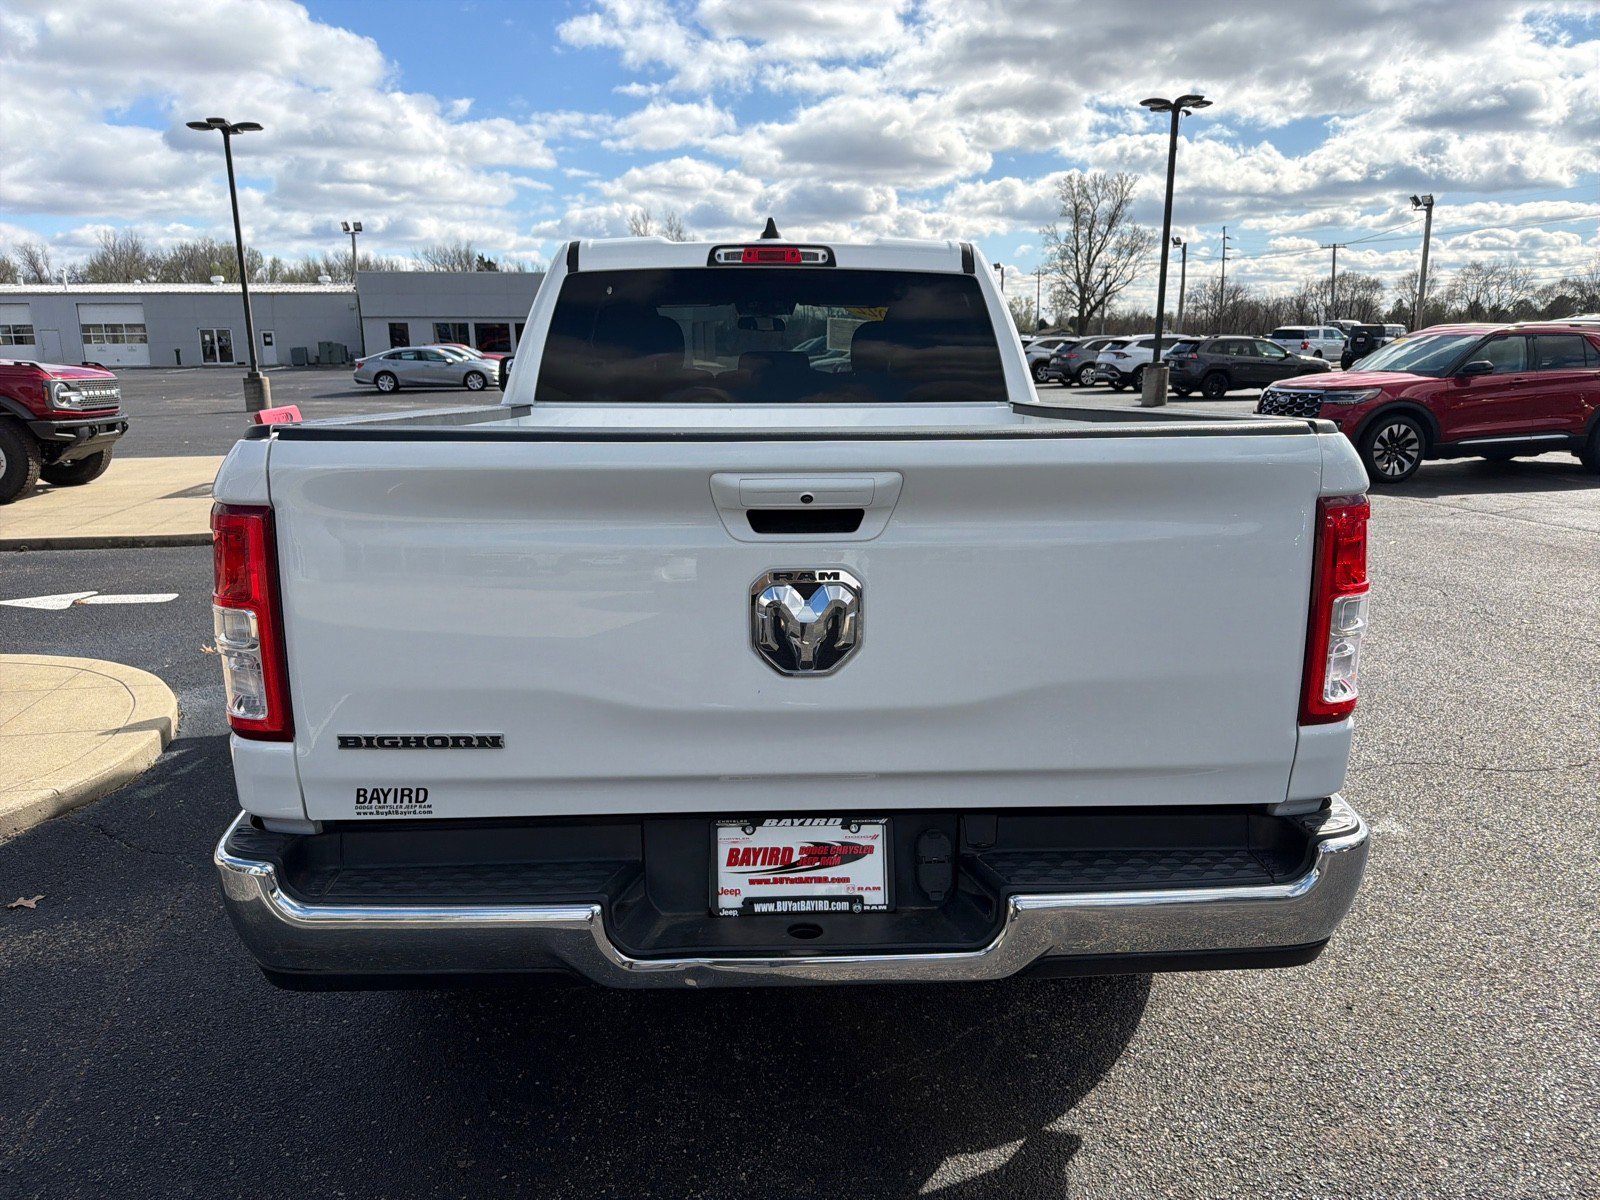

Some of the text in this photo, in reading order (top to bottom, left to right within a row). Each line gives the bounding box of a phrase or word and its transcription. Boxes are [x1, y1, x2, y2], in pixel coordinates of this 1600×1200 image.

[772, 571, 841, 581] RAM
[337, 735, 504, 749] BIGHORN
[355, 787, 429, 804] BAYIRD
[762, 818, 843, 827] BAYIRD
[798, 845, 875, 856] DODGE CHRYSLER
[726, 846, 794, 867] BAYIRD
[797, 856, 841, 867] JEEP RAM
[748, 876, 850, 885] www.BUYatBAYIRD.com
[718, 887, 741, 897] Jeep
[754, 901, 849, 912] www.BUYatBAYIRD.com
[719, 909, 739, 917] Jeep
